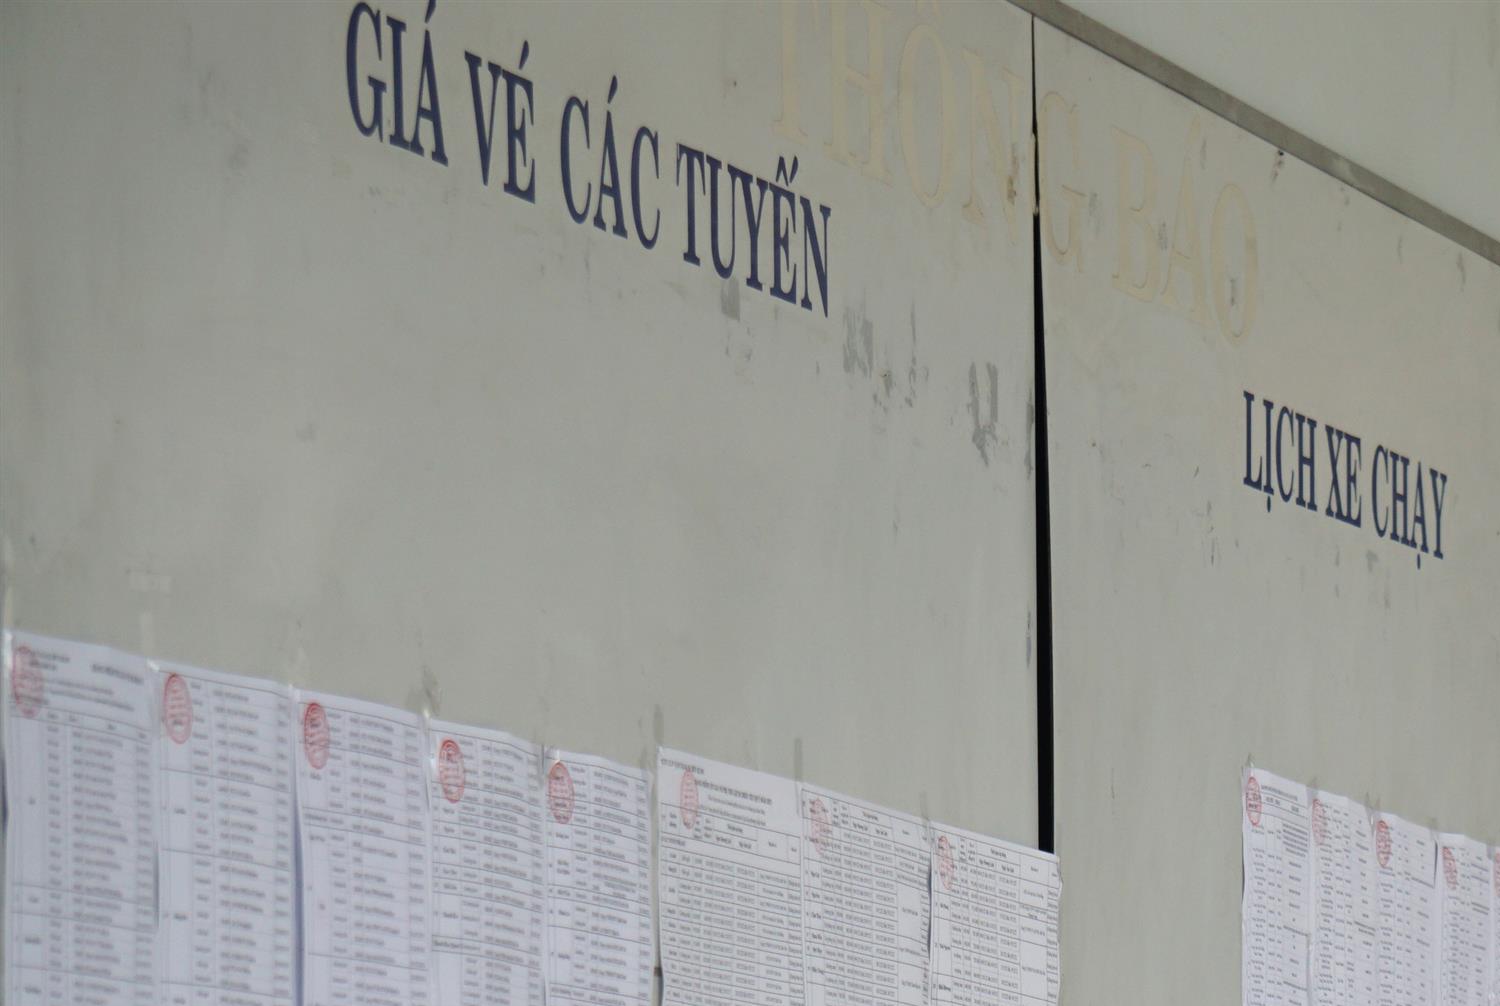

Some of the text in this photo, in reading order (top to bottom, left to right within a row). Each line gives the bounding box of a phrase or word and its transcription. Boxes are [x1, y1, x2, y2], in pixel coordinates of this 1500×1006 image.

[345, 0, 832, 318] GIÁ VÉ CÁC TUYẾN
[1243, 390, 1448, 570] LỊCH XE CHẠY
